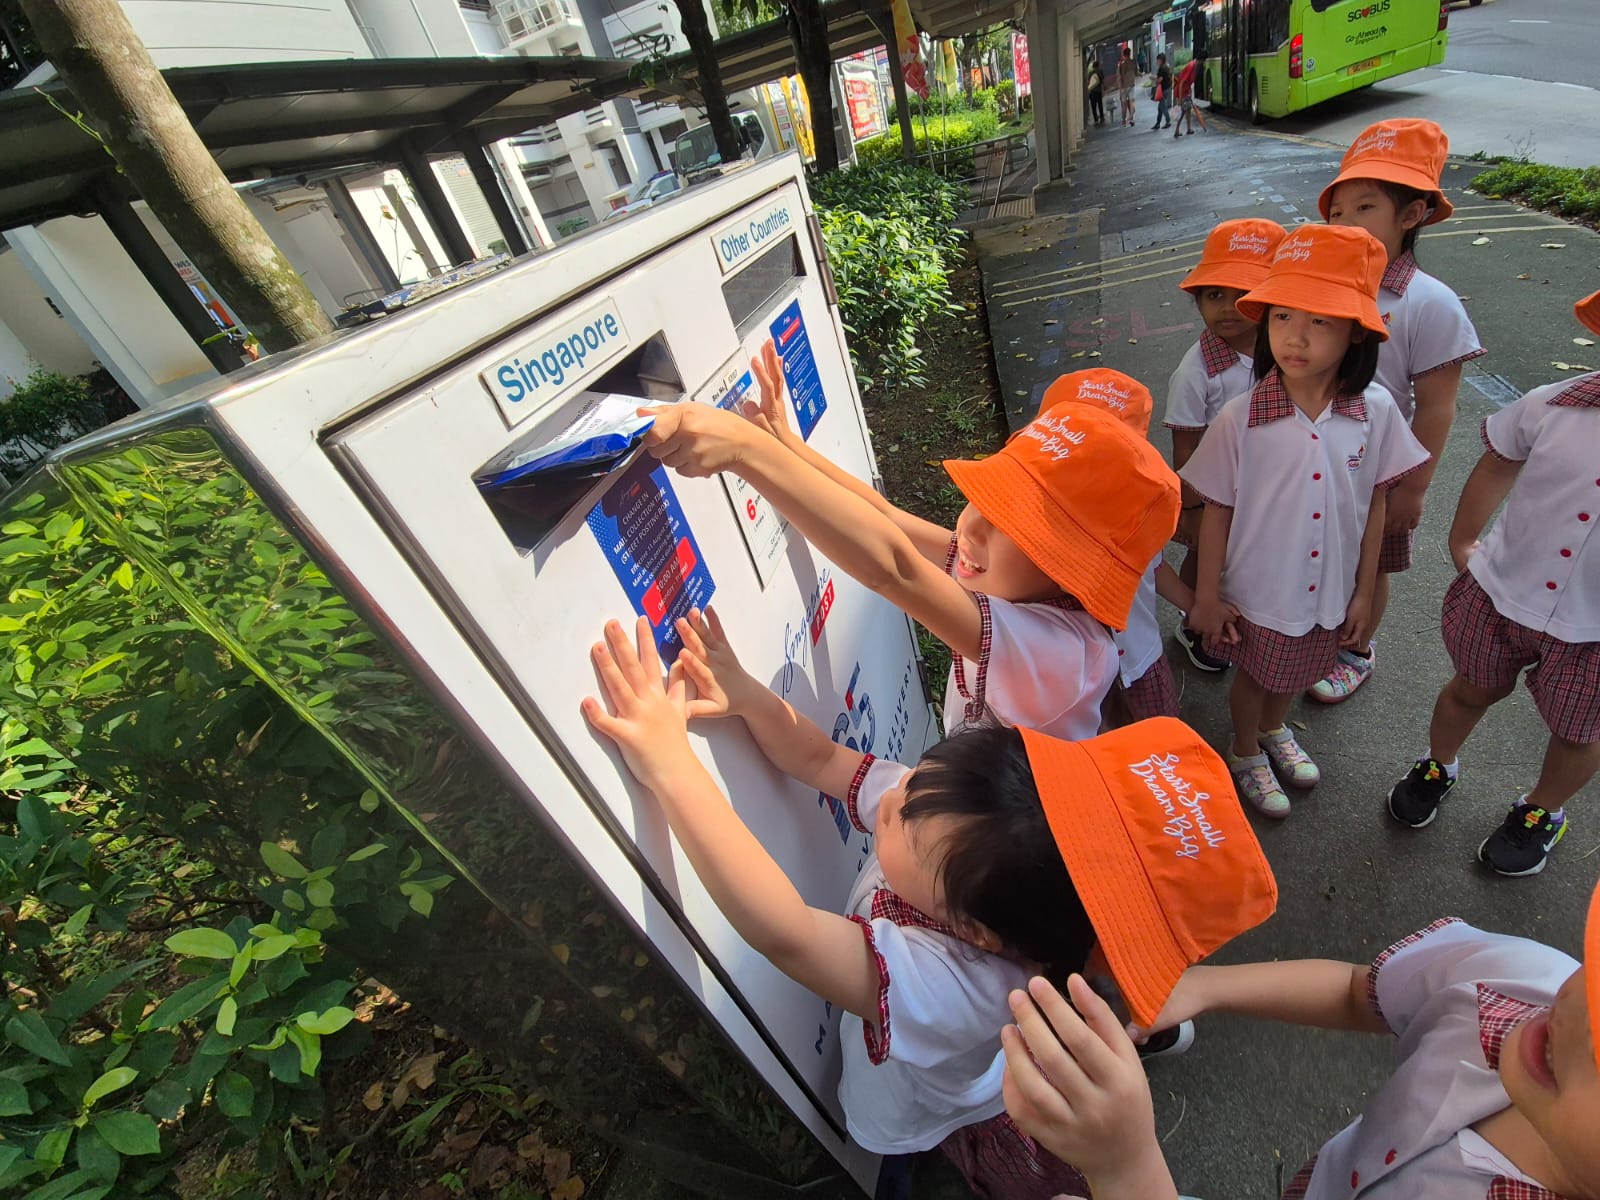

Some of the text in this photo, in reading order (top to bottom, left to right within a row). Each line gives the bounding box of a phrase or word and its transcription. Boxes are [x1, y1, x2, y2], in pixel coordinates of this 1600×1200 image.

[721, 207, 790, 262] Other Countries
[497, 313, 619, 403] Singapore
[613, 536, 628, 555] MAIL
[626, 500, 656, 538] COLLECTION
[654, 486, 667, 503] TIME
[622, 500, 644, 525] CHANGE
[746, 498, 757, 520] 6
[620, 537, 641, 565] (STREET
[638, 512, 660, 540] POSTING
[656, 569, 671, 593] 10:00
[814, 586, 834, 631] POST
[782, 567, 831, 700] Singapore
[1127, 758, 1200, 861] Dream Big
[1150, 752, 1226, 848] Start Small
